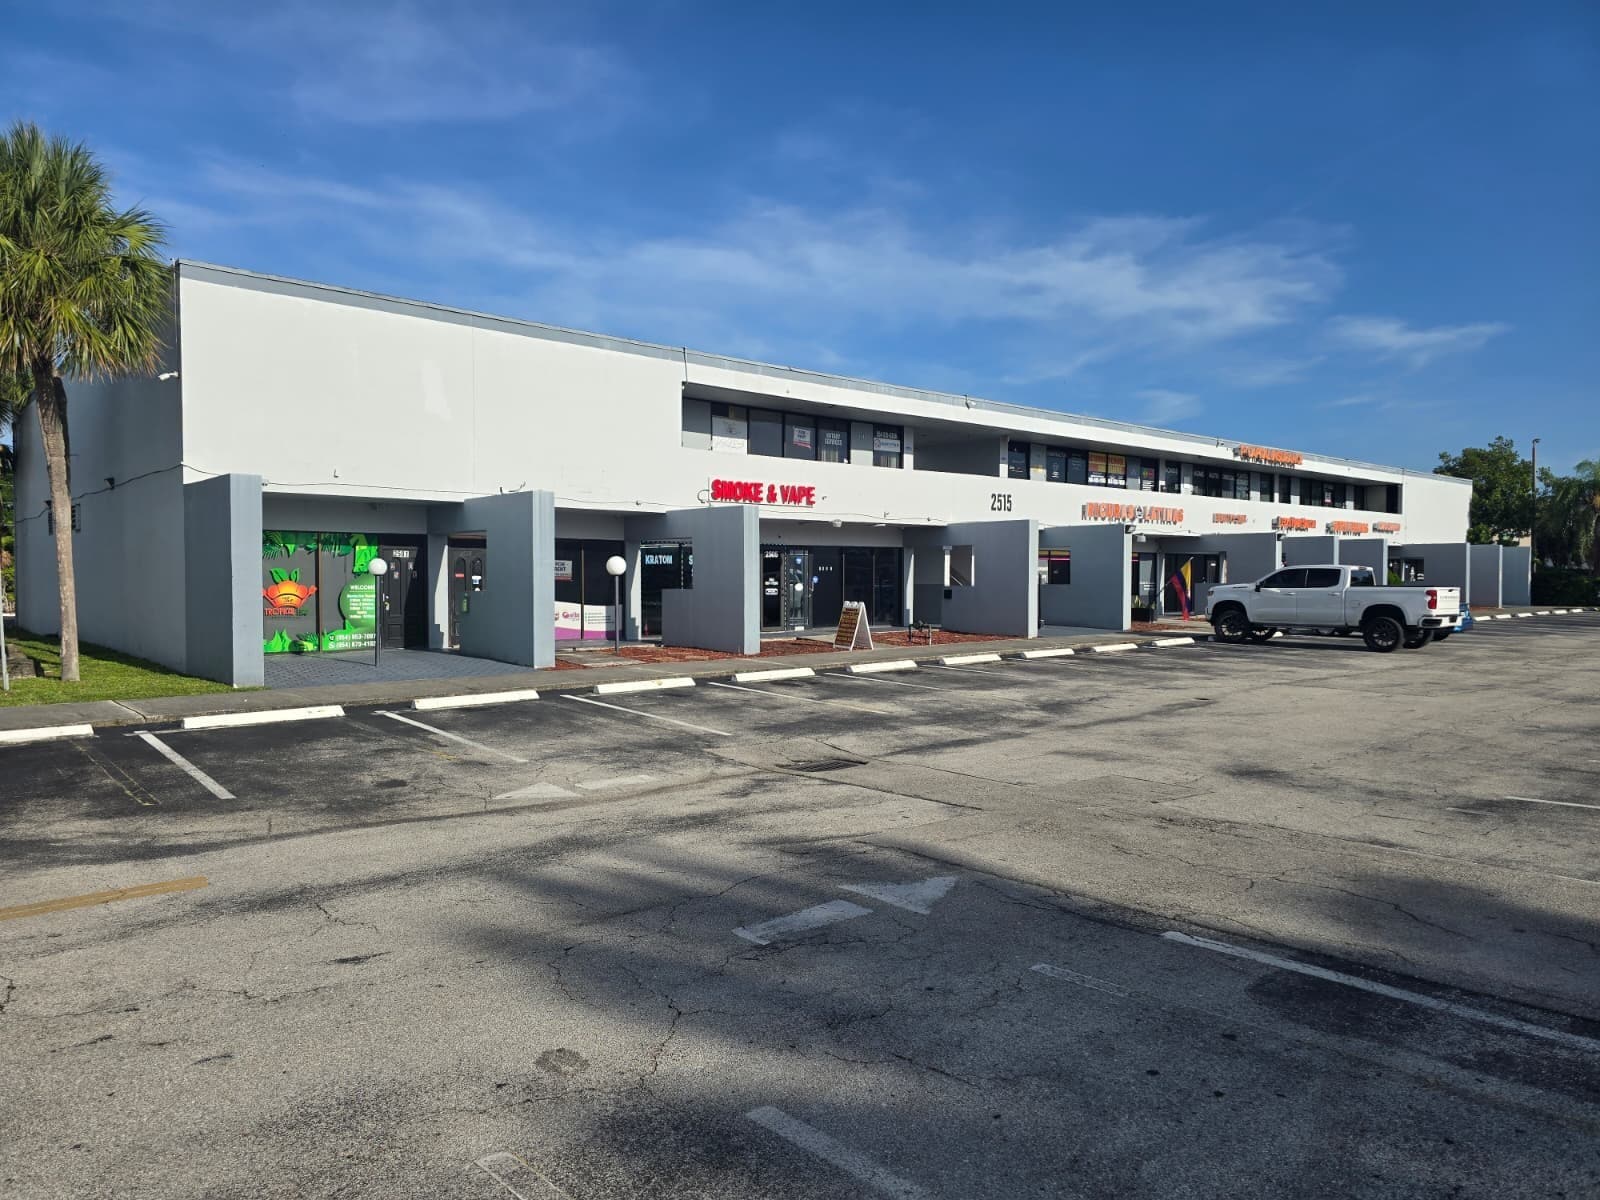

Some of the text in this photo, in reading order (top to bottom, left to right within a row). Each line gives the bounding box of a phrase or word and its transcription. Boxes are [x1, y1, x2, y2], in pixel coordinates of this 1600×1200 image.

[711, 479, 816, 505] SMOKE & VAPE
[990, 493, 1012, 512] 2515
[645, 554, 673, 565] KRATOM
